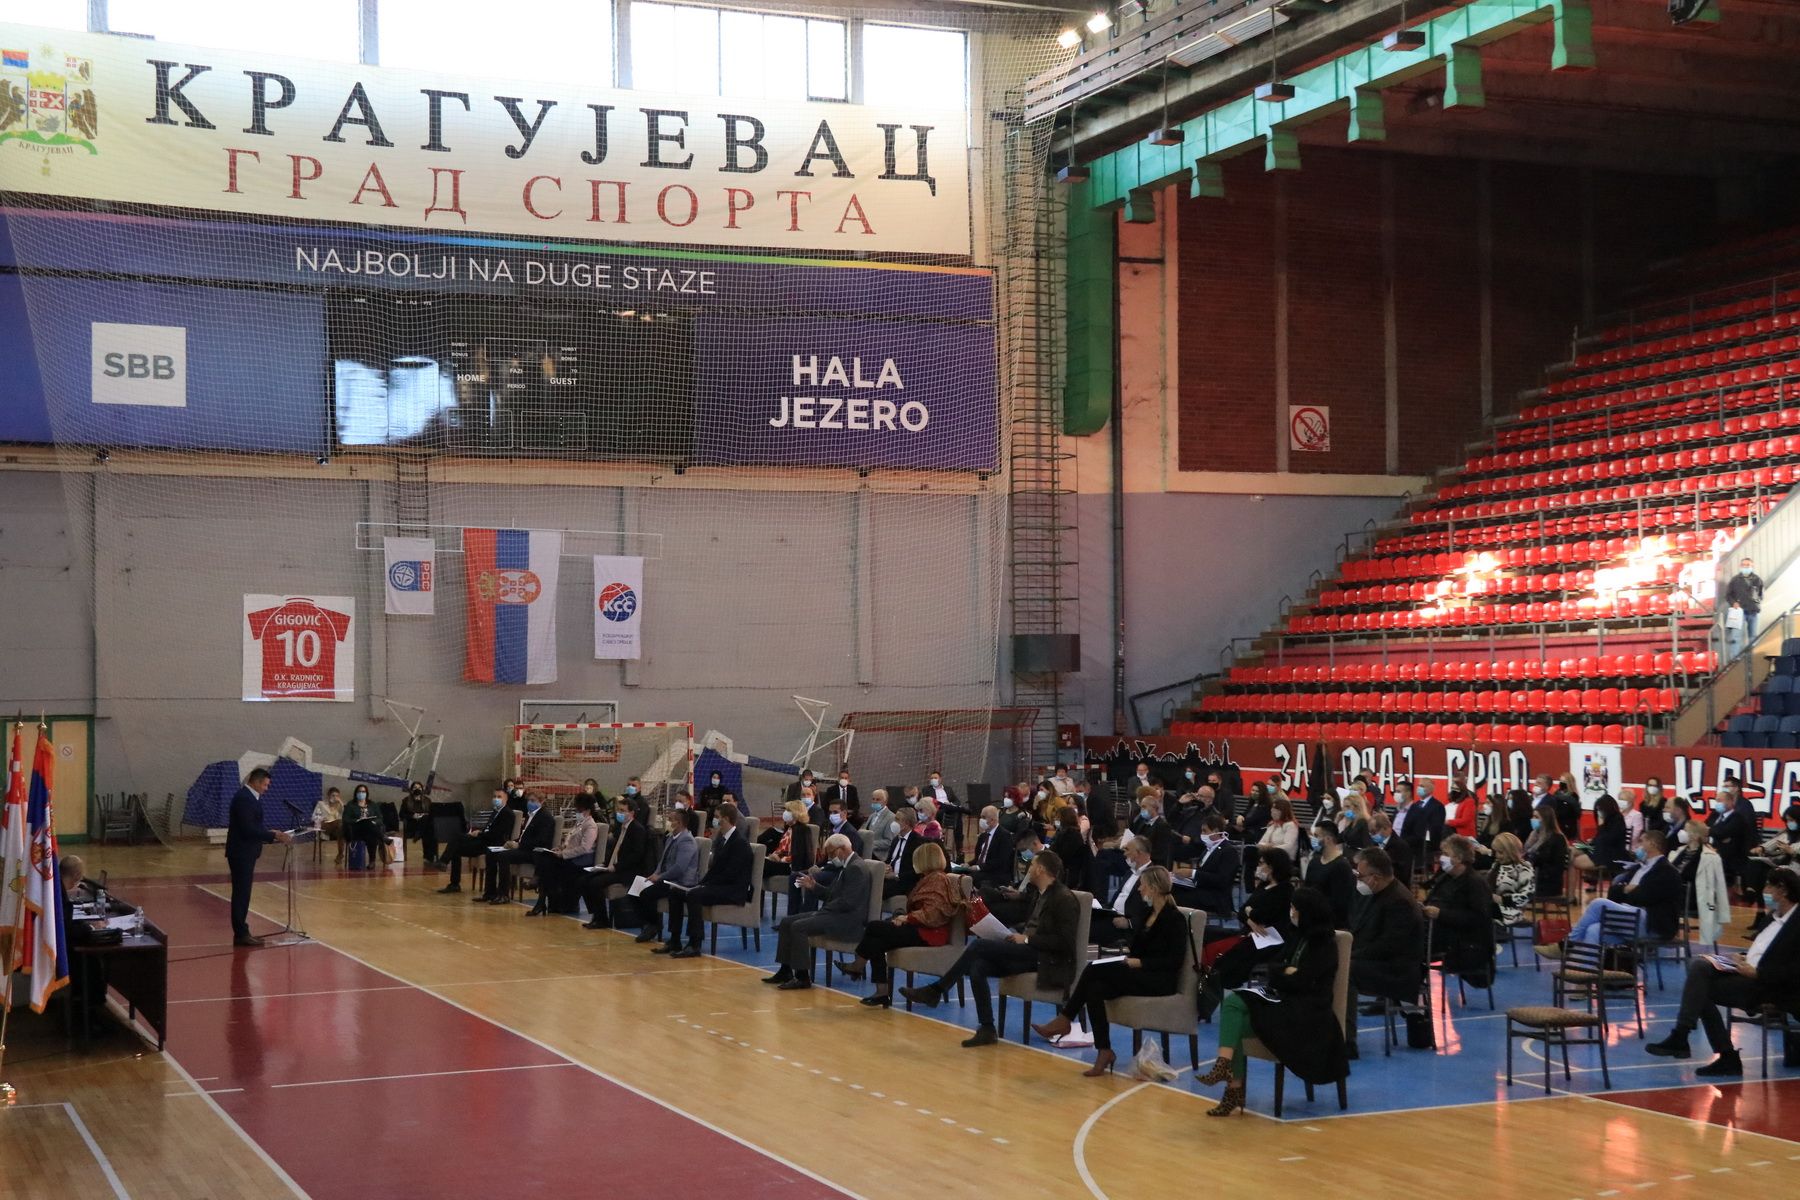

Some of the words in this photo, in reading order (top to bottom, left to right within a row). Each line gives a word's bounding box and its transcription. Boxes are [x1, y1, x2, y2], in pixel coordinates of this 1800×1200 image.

[145, 59, 936, 196] КРАГУЈЕВАЦ
[222, 148, 467, 224] ГРАД
[522, 175, 877, 235] СПОРТА
[296, 247, 455, 280] NAJBOLJI
[468, 257, 514, 283] NA
[526, 260, 612, 288] DUGE
[623, 266, 716, 295] STAZE
[103, 352, 176, 380] SBB
[457, 373, 486, 383] HOME
[549, 377, 578, 386] GUEST
[792, 354, 904, 390] HALA
[768, 397, 930, 433] JEZERO
[275, 612, 322, 626] GIGOVIĆ
[275, 629, 322, 668] 10
[277, 682, 321, 691] KRAGUJEVAC
[1273, 743, 1310, 791] ЗА
